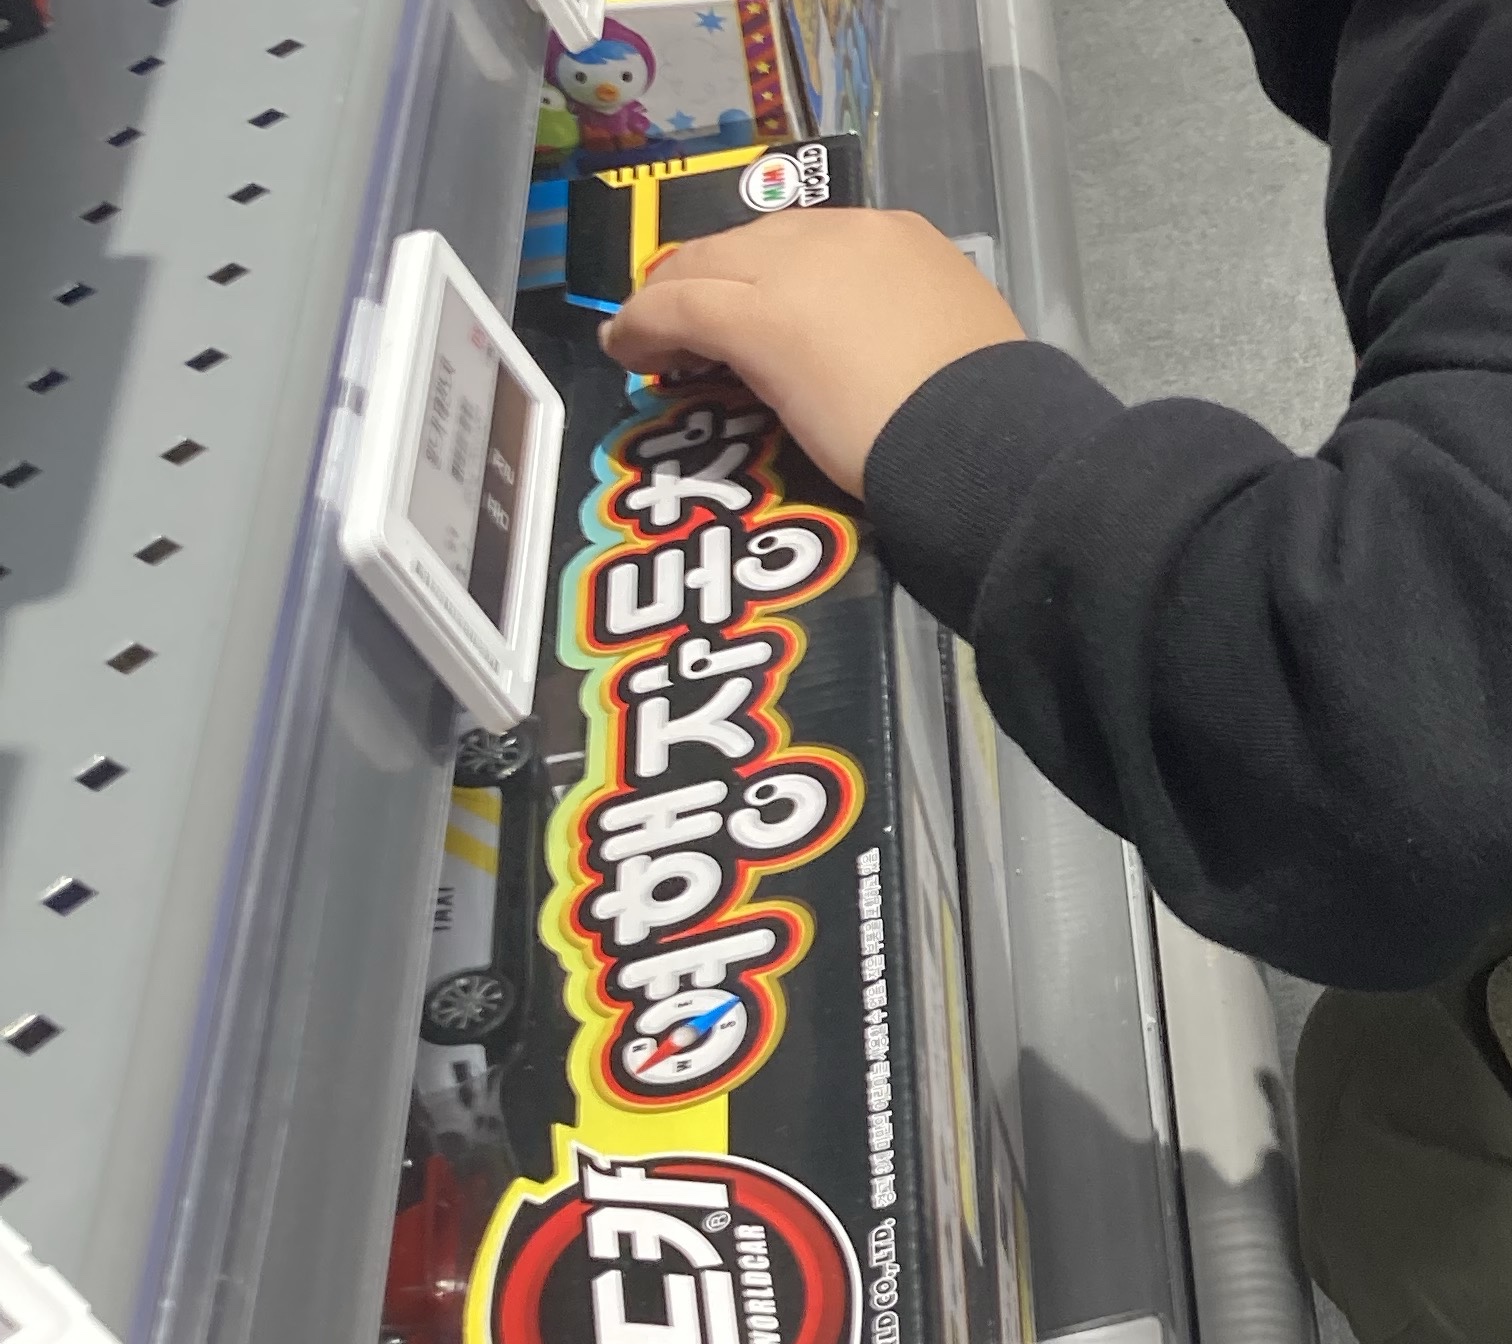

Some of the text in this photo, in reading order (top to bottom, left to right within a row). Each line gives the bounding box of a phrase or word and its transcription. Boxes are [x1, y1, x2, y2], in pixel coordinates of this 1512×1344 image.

[761, 163, 787, 202] MIMI
[802, 147, 827, 207] WORLD
[864, 1007, 888, 1025] 수
[868, 1061, 892, 1112] 어린이는
[869, 1110, 894, 1152] 미만의
